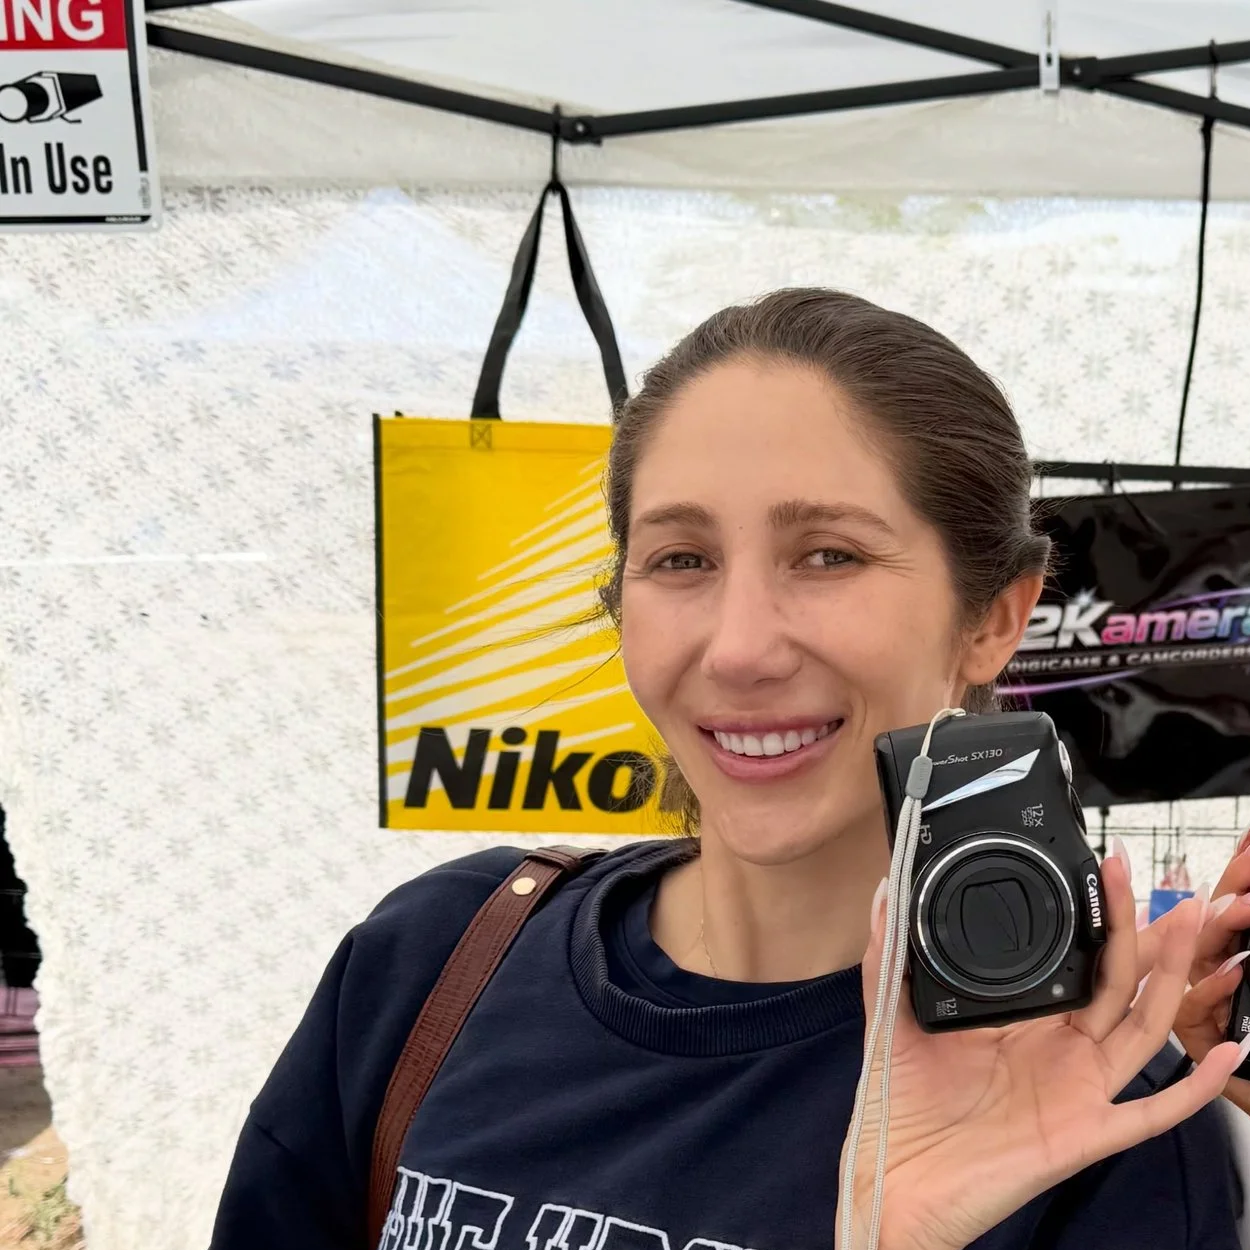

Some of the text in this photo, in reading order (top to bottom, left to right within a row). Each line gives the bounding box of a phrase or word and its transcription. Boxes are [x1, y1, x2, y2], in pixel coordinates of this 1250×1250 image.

[0, 143, 33, 194] In
[44, 142, 113, 194] Use
[1107, 654, 1121, 668] &
[970, 748, 1003, 761] SX130
[1086, 873, 1102, 928] Canon
